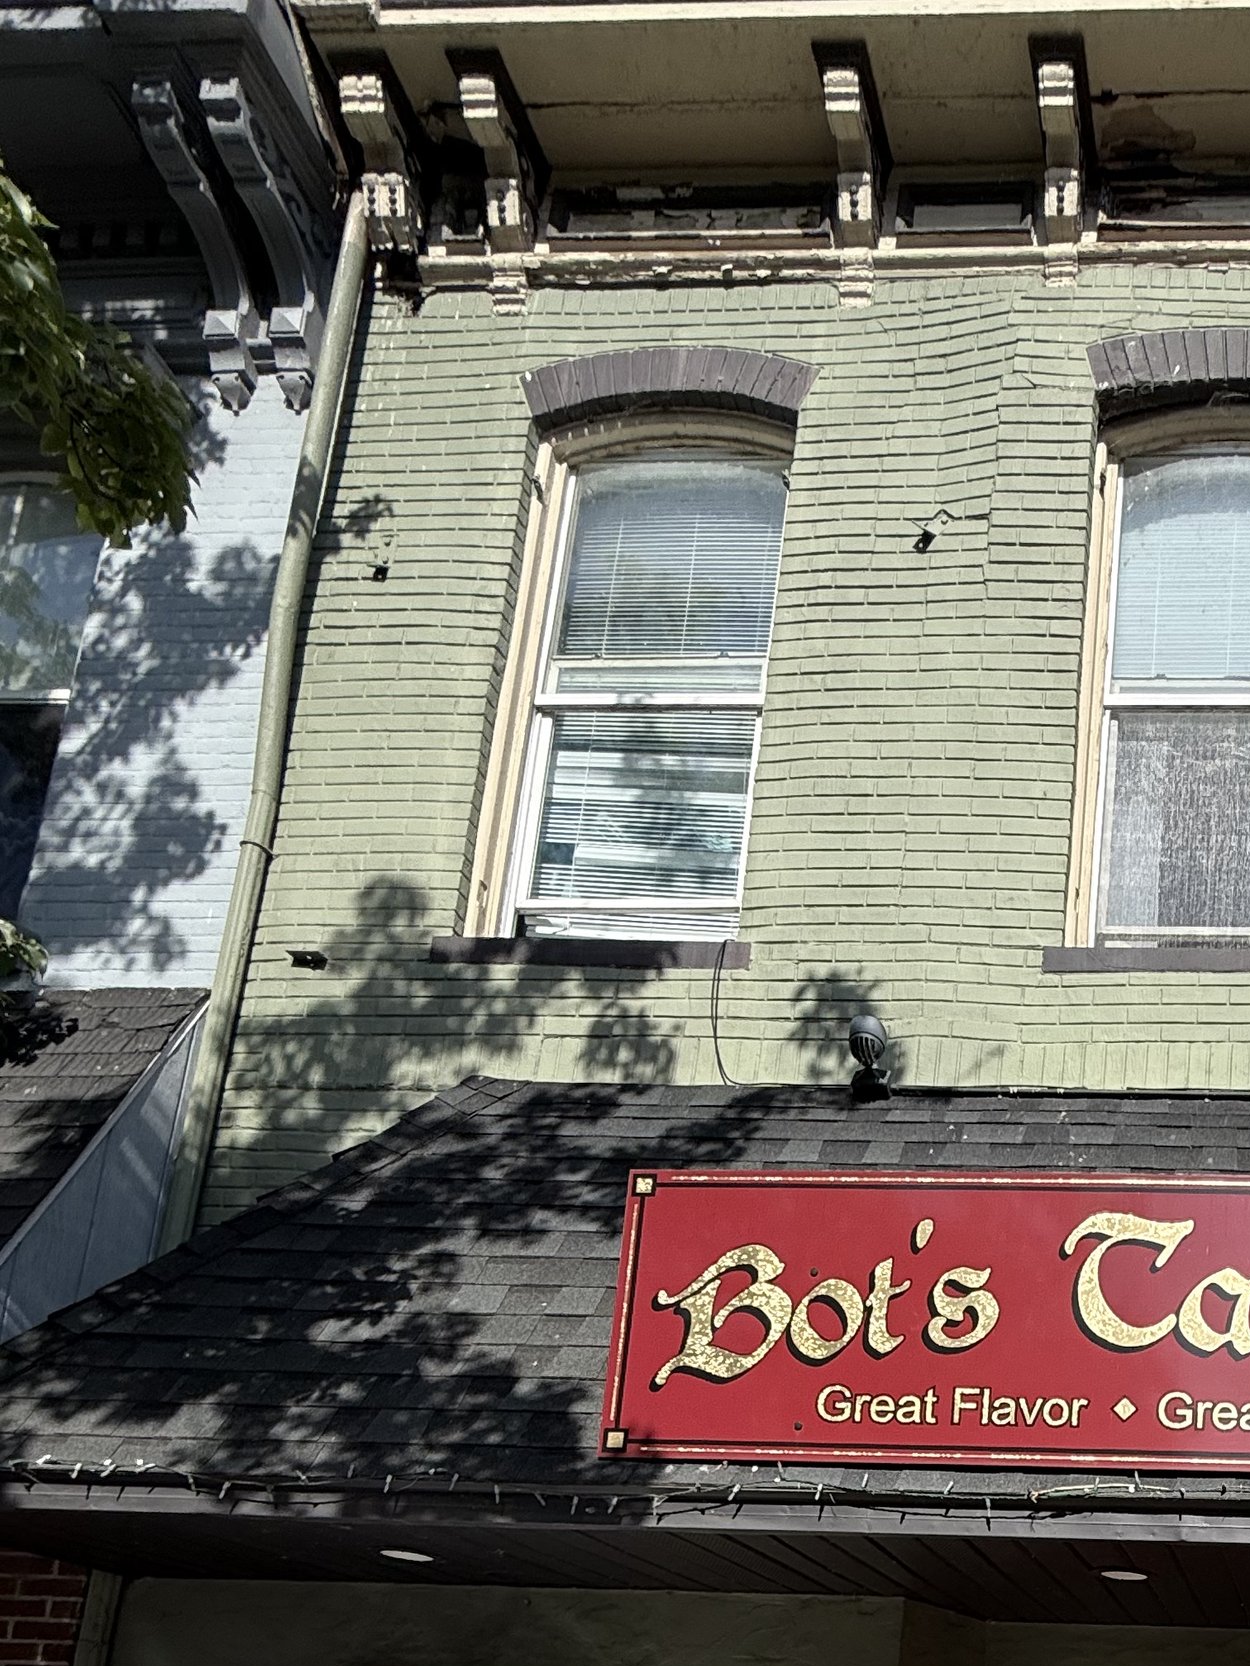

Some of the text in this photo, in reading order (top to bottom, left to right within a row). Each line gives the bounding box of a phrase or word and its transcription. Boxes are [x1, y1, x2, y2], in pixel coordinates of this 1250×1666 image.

[654, 1219, 1000, 1388] Bot's
[816, 1384, 938, 1424] Great
[951, 1386, 1089, 1427] Flavor
